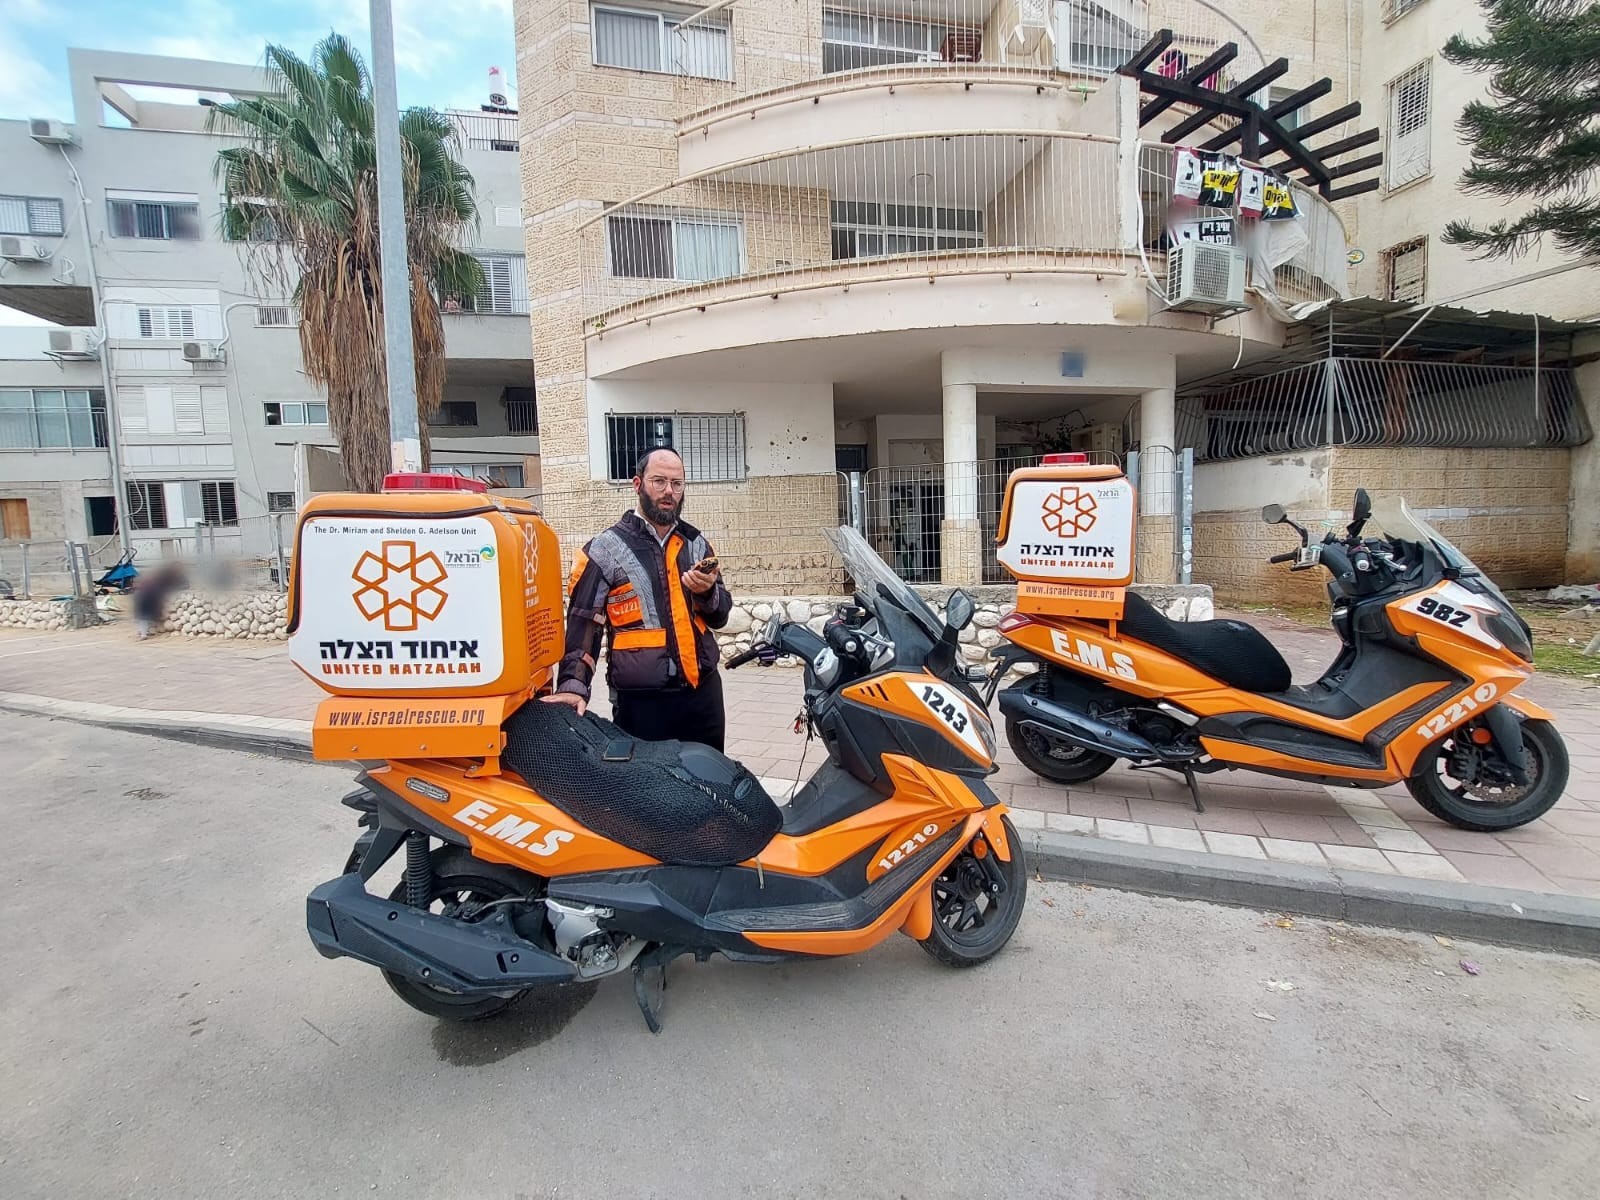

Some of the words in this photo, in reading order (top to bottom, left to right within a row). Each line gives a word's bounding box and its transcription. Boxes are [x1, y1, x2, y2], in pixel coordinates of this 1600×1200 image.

[314, 526, 328, 534] The
[329, 526, 341, 534] Dr.
[342, 526, 368, 535] Miriam
[370, 527, 384, 535] and
[386, 527, 416, 535] Sheldon
[418, 527, 427, 535] G.
[429, 527, 459, 535] Adelson
[445, 551, 480, 563] הראל
[1020, 544, 1064, 557] הצלה
[1068, 546, 1115, 558] איחוד
[1020, 558, 1056, 567] UNITED
[1060, 560, 1114, 569] HATZALAH
[1025, 585, 1115, 600] www.israelrescue.org
[1416, 597, 1472, 628] 982
[319, 639, 394, 660] הצלה
[400, 639, 479, 659] איחוד
[1050, 628, 1137, 680] E.M.S
[321, 663, 382, 675] UNITED
[389, 662, 481, 675] HATZALAH
[329, 708, 485, 727] www.israelrescue.org
[922, 685, 968, 734] 1243
[1417, 695, 1478, 740] 1221
[452, 799, 576, 857] E.M.S
[878, 833, 927, 871] 1221
